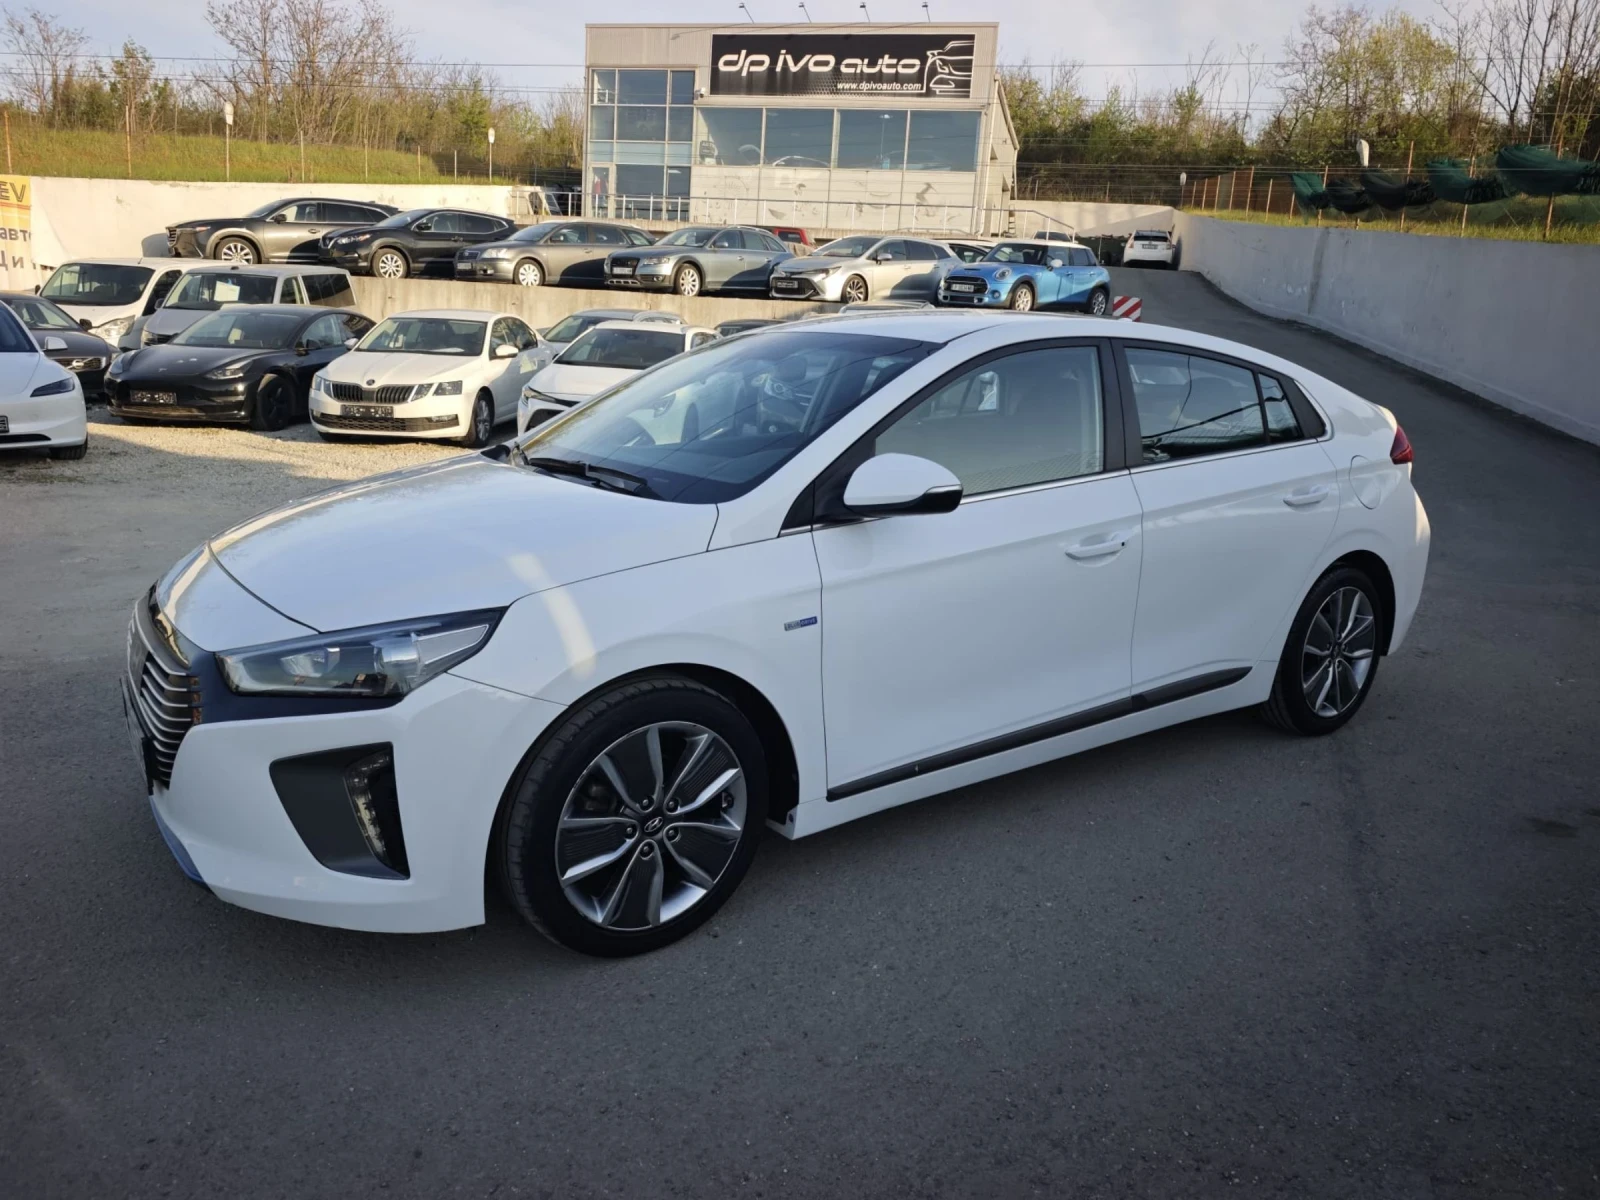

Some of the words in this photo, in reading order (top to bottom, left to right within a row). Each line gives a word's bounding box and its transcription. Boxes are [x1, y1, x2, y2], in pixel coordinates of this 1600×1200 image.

[718, 50, 770, 76] dp
[776, 50, 836, 73] ivo
[840, 54, 921, 74] auto
[837, 81, 921, 92] www.dpivoauto.com
